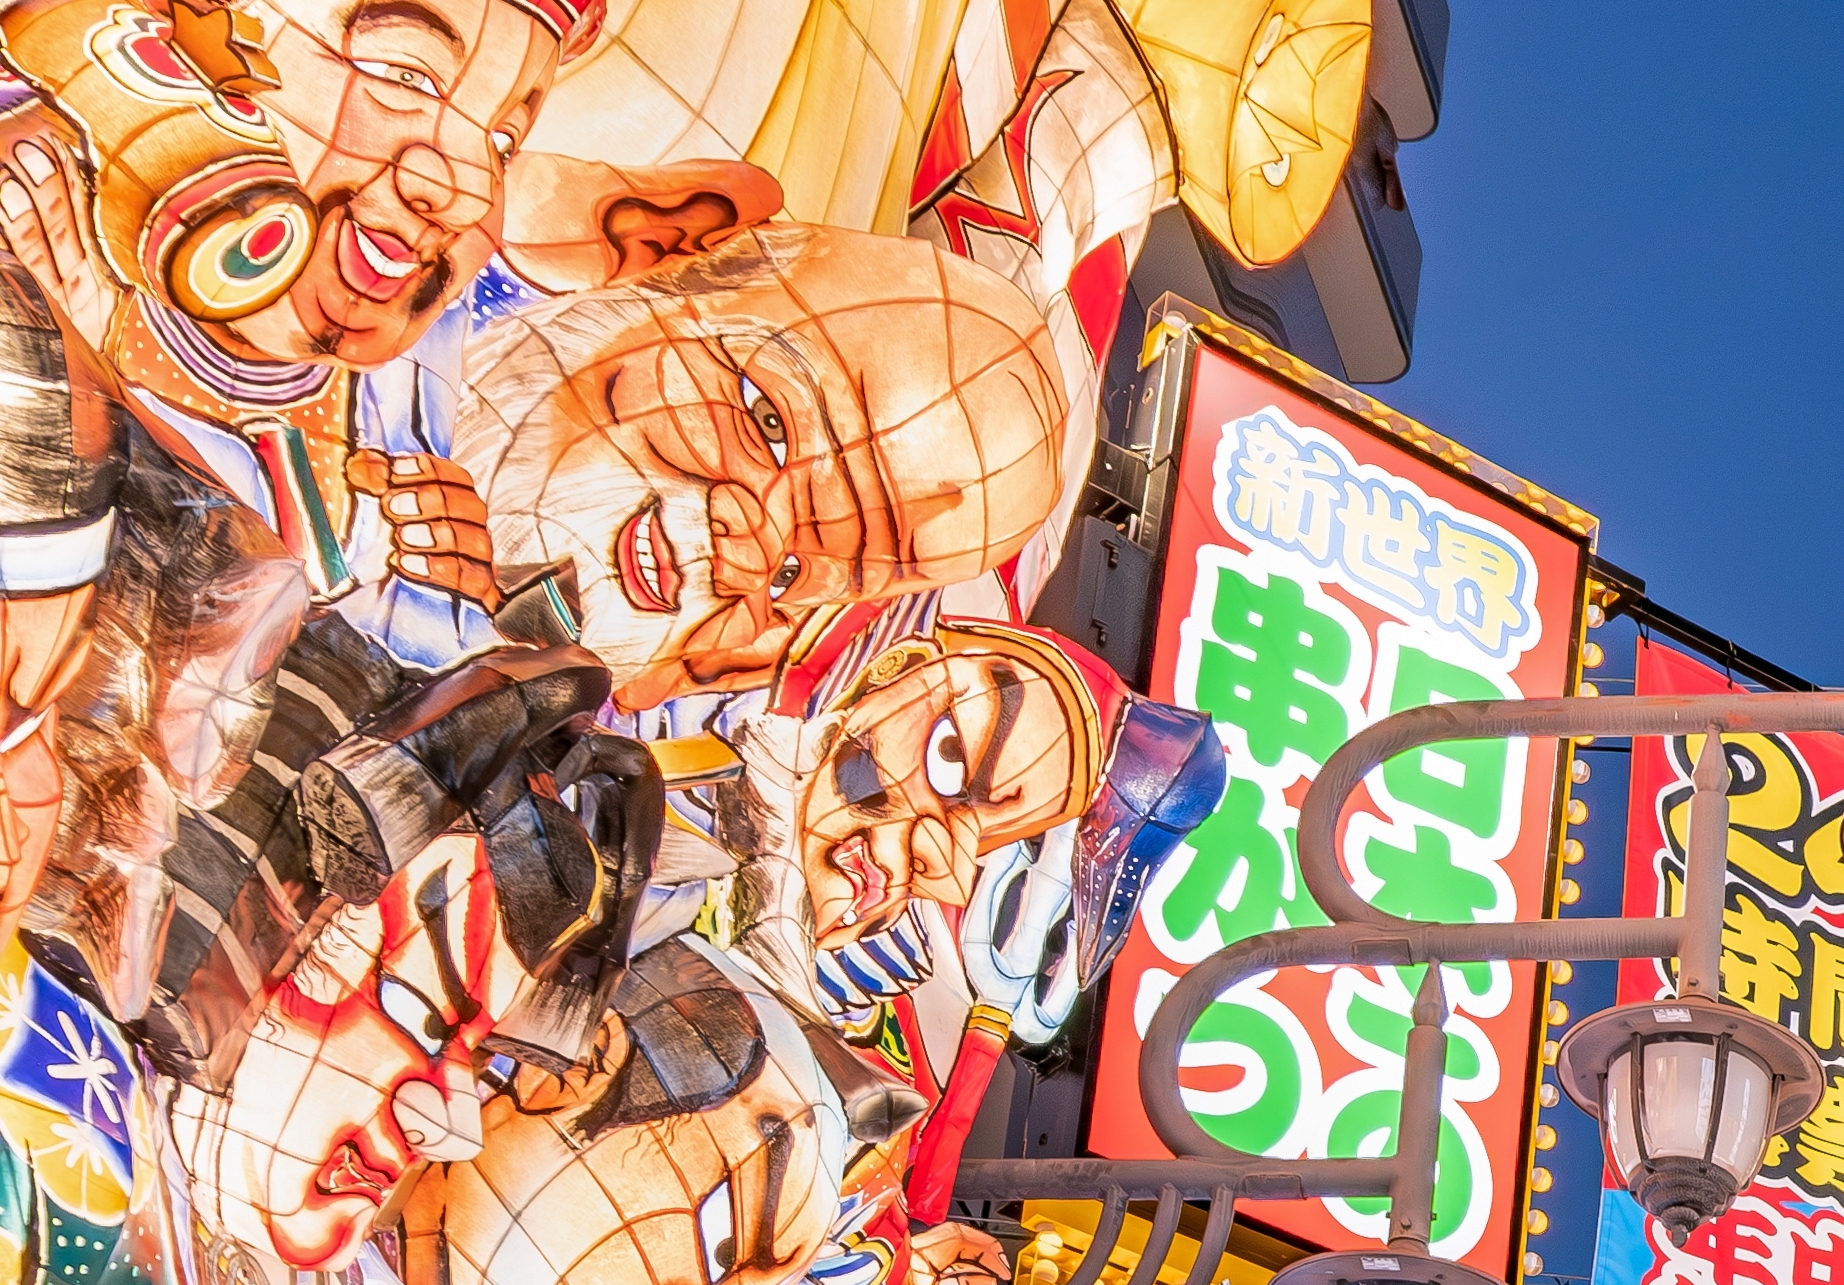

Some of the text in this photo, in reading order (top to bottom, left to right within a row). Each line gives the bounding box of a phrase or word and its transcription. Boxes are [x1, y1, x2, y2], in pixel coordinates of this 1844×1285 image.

[1230, 419, 1528, 650] 新世界
[1159, 566, 1355, 1158] 串かつ
[1326, 617, 1511, 1244] 日本一の
